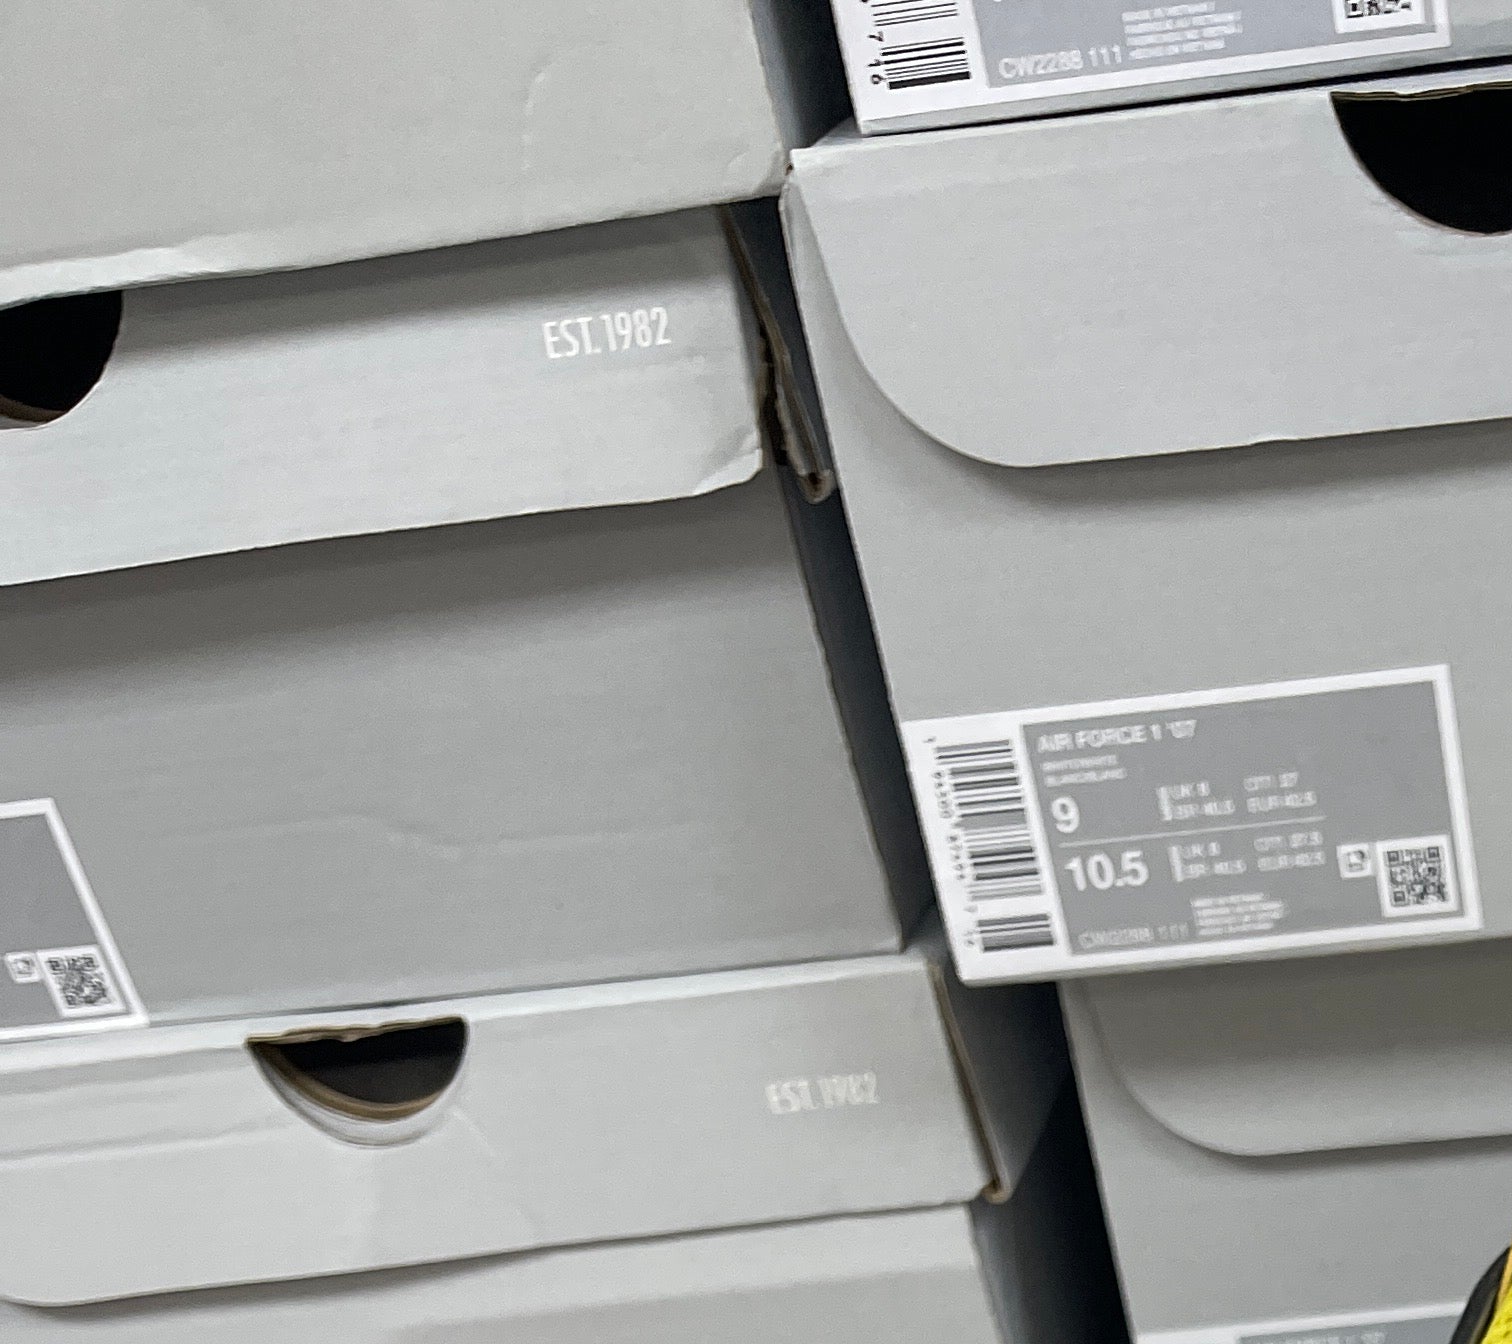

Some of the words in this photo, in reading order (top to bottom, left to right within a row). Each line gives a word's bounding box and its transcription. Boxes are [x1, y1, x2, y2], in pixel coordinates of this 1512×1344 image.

[1087, 44, 1123, 67] 111
[543, 306, 672, 359] EST.1982
[1051, 796, 1081, 833] 9
[1064, 850, 1150, 892] 10.5
